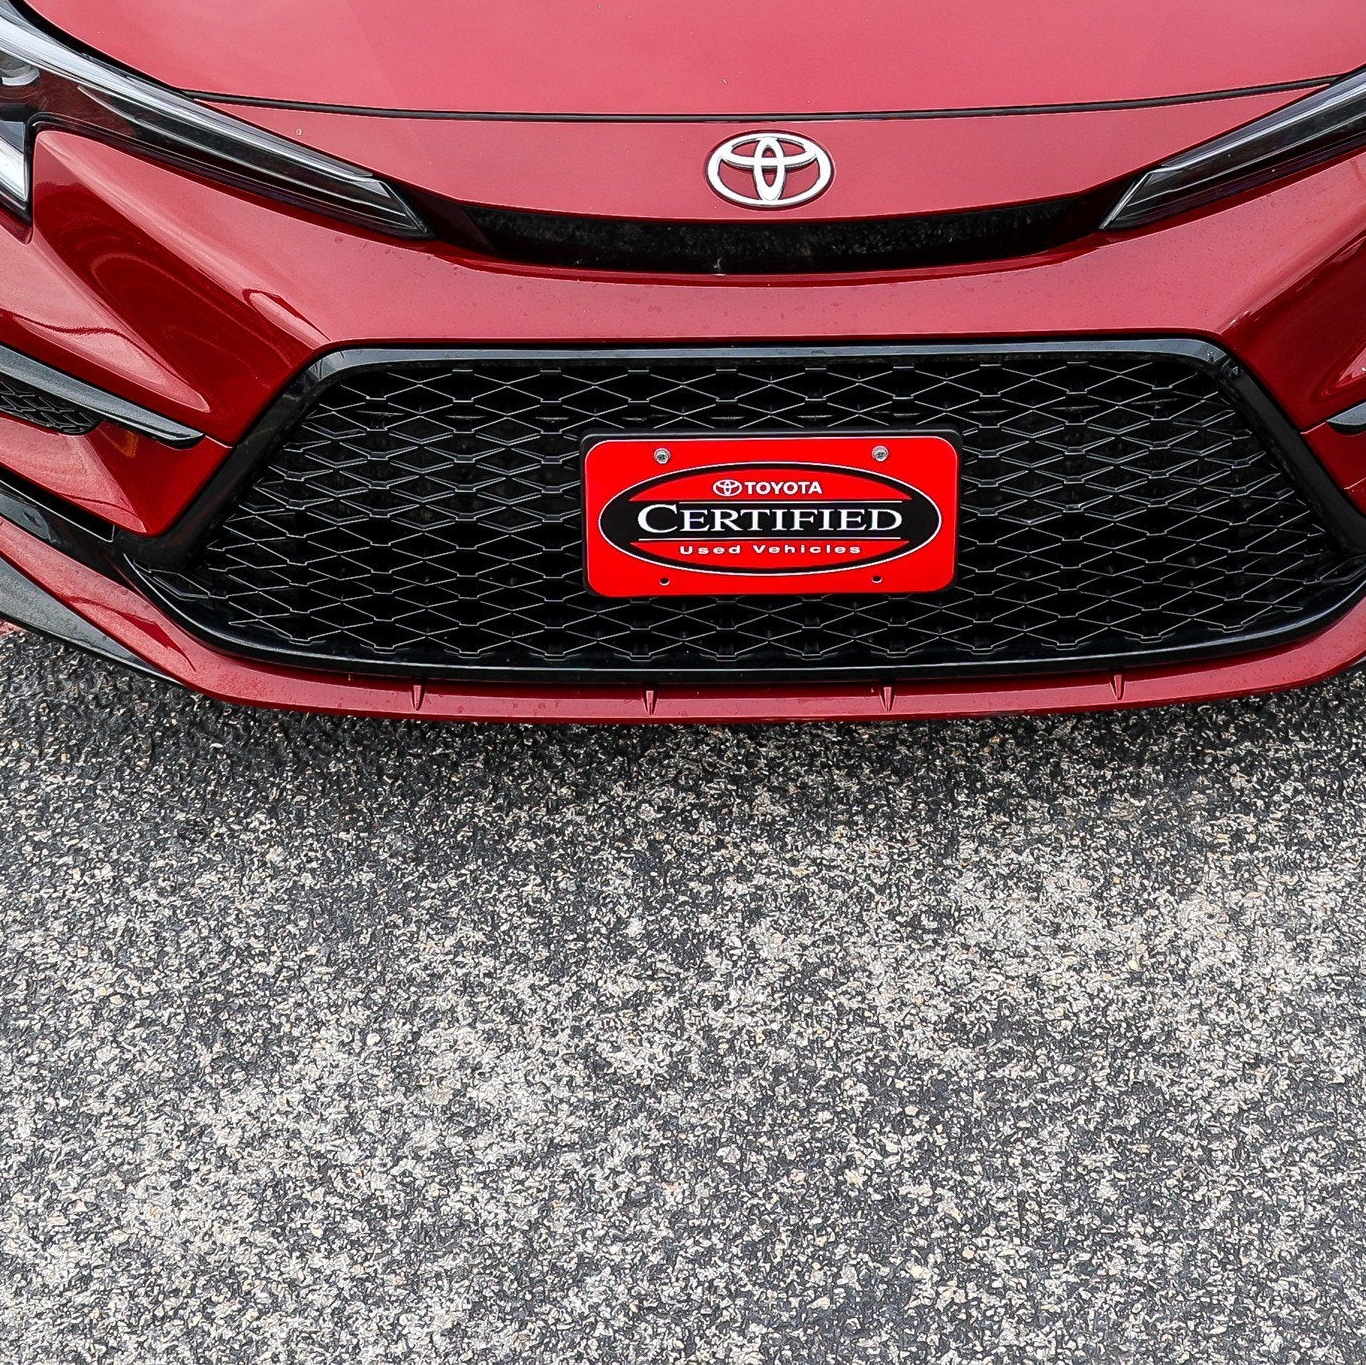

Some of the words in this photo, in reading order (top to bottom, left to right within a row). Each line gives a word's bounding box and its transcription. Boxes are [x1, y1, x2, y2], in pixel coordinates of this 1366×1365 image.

[744, 480, 823, 496] TOYOTA
[636, 503, 903, 533] CERTIFIED
[679, 544, 742, 556] Used
[752, 543, 862, 556] Vehicles
